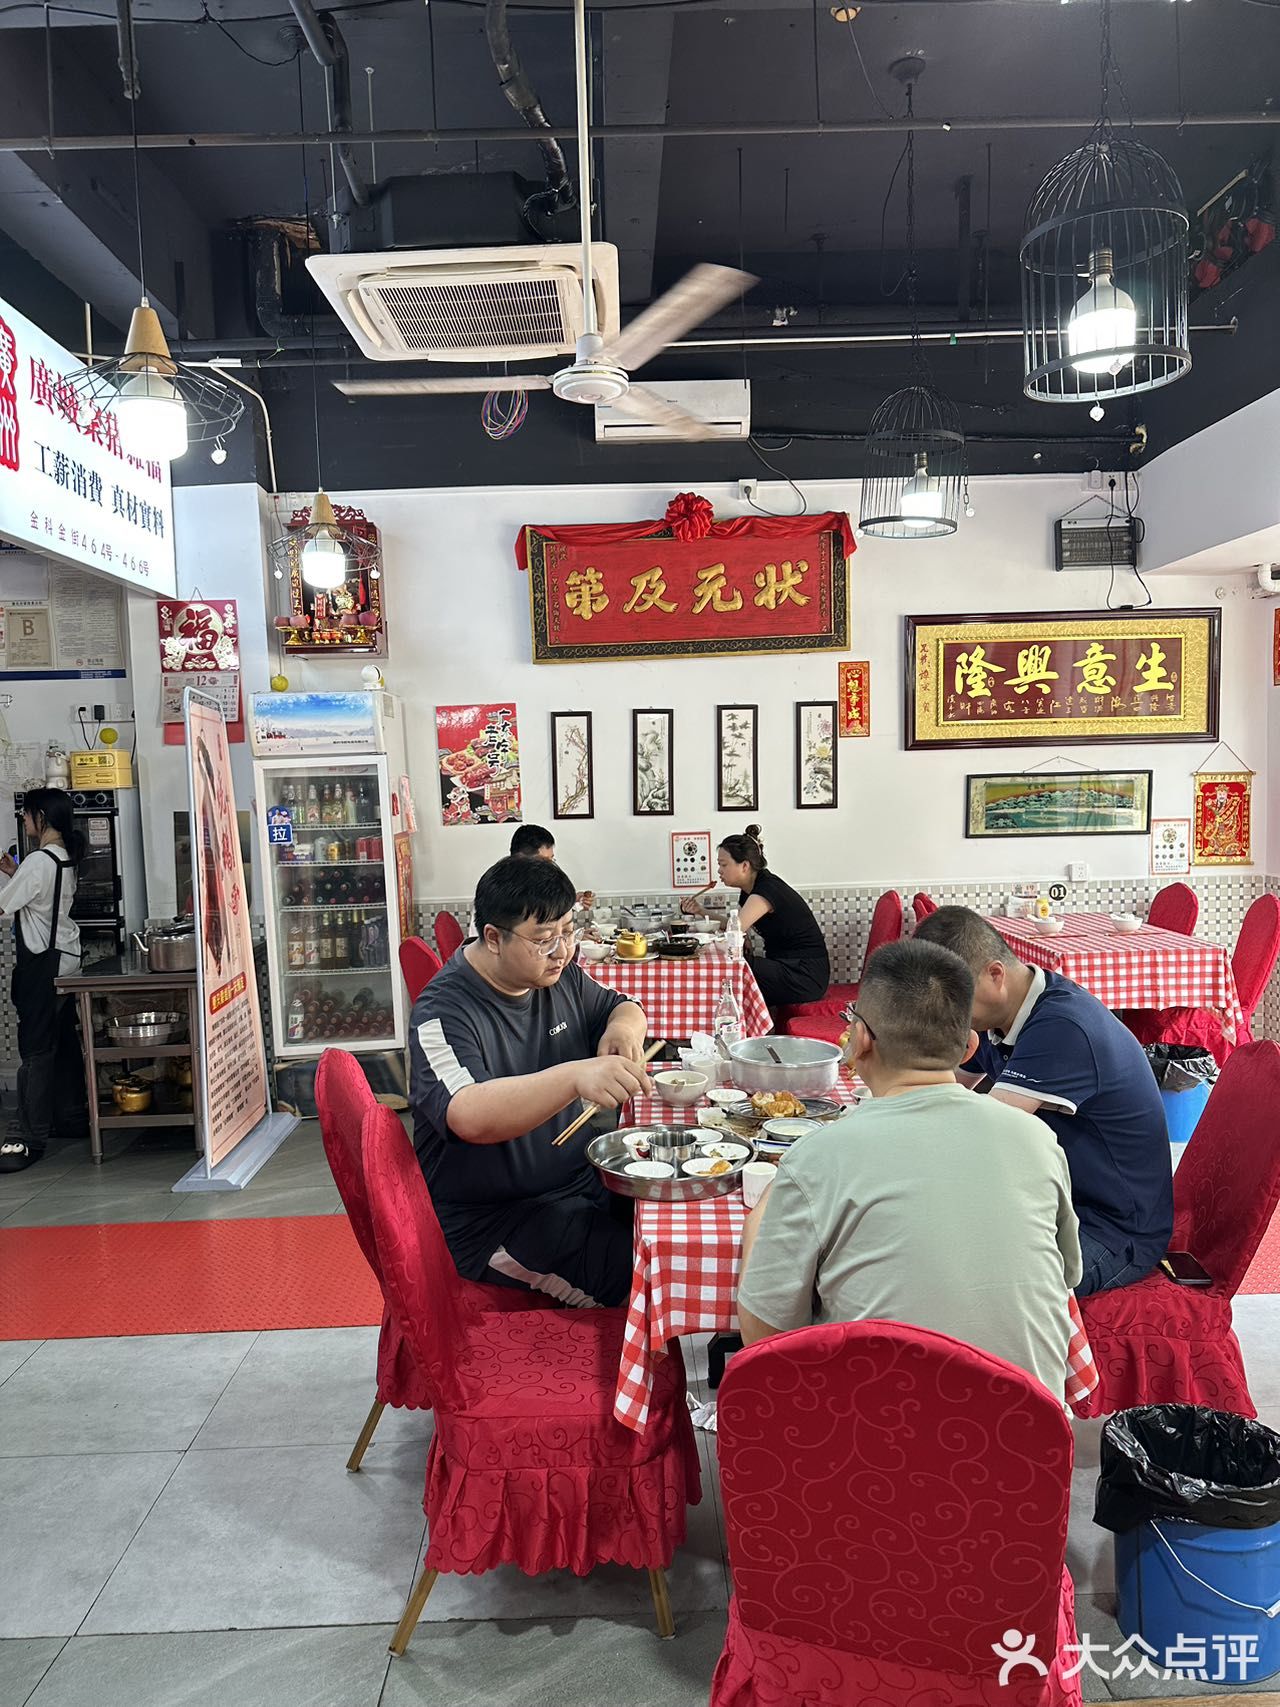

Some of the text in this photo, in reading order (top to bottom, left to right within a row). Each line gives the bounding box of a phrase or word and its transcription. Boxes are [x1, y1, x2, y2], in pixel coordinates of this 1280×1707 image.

[34, 440, 164, 539] 工薪消費 真材實料
[22, 619, 35, 636] B
[196, 675, 207, 686] 12
[272, 827, 288, 842] 拉
[1050, 886, 1065, 898] 01
